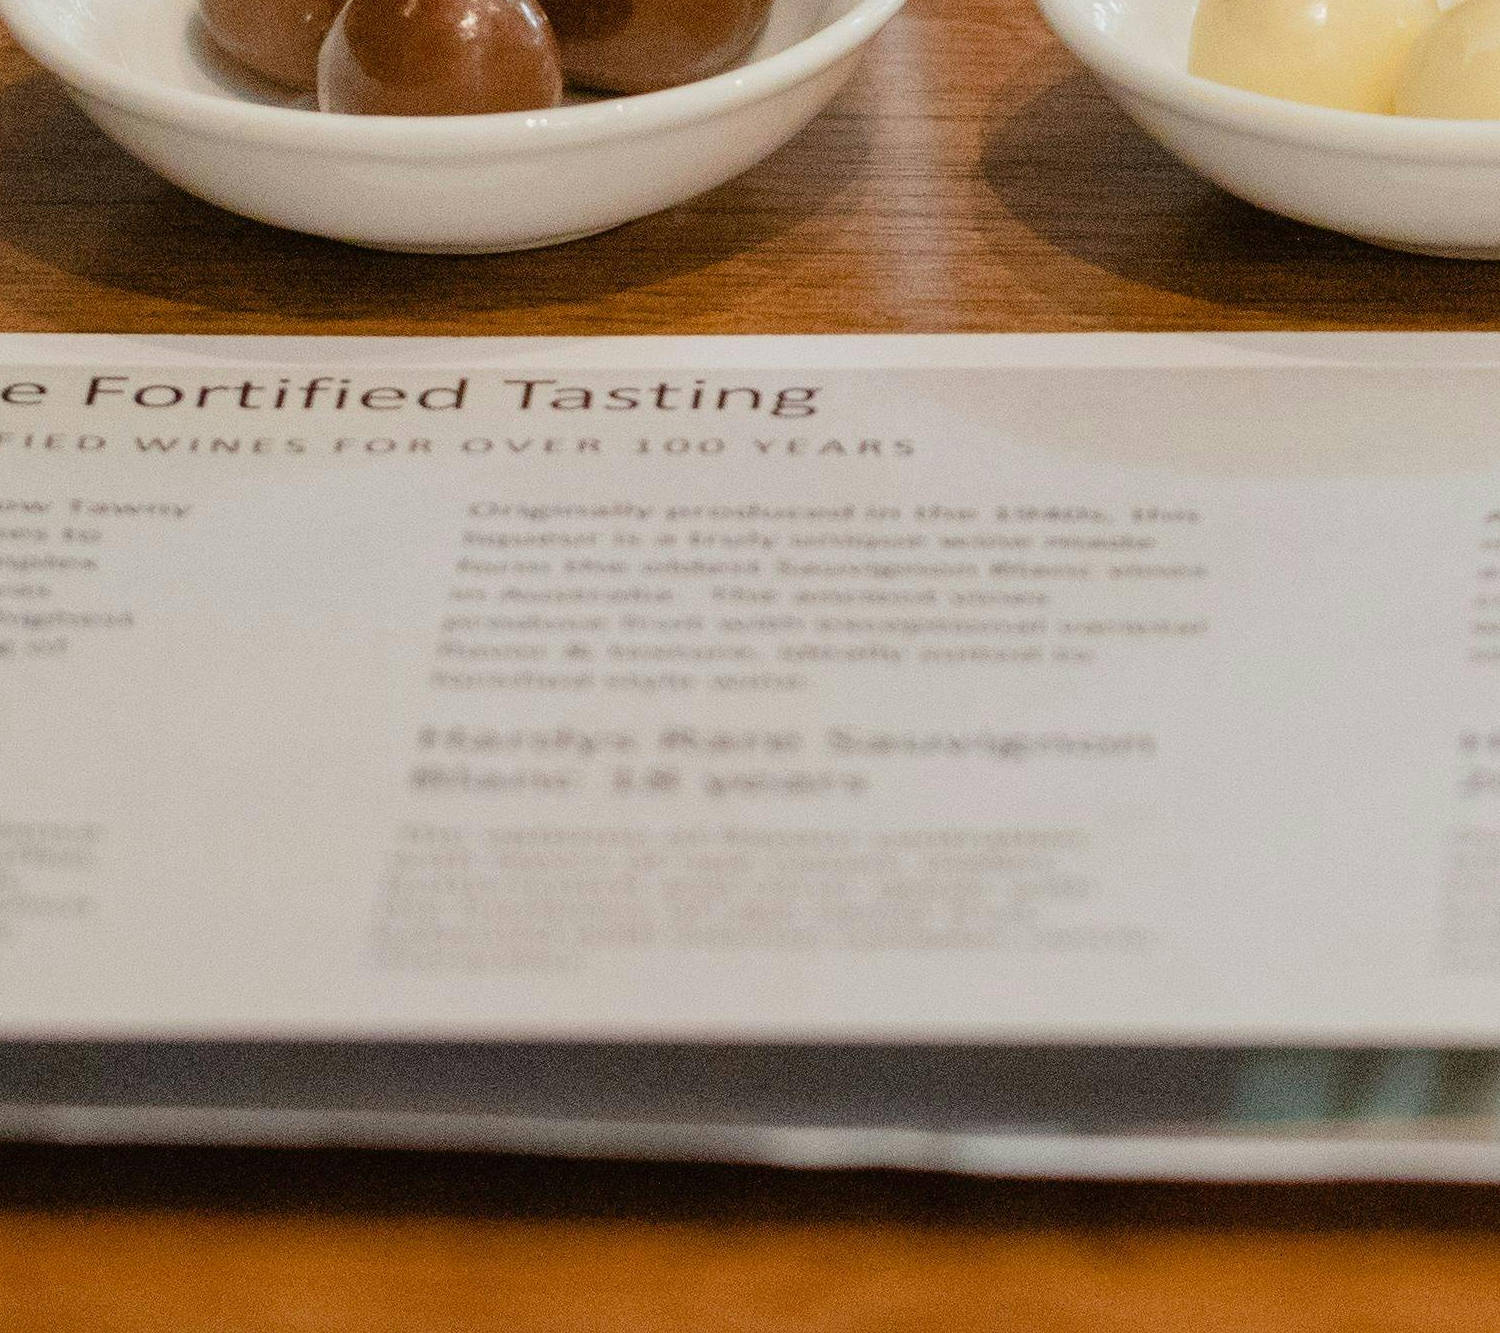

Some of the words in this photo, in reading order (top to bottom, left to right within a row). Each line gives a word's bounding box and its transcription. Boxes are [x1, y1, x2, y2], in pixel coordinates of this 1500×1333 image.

[85, 375, 471, 411] Fortified
[503, 378, 823, 418] Tasting
[134, 435, 306, 455] WINES
[334, 437, 433, 455] FOR
[461, 437, 604, 455] OVER
[635, 437, 725, 455] 100
[755, 438, 916, 456] YEARS
